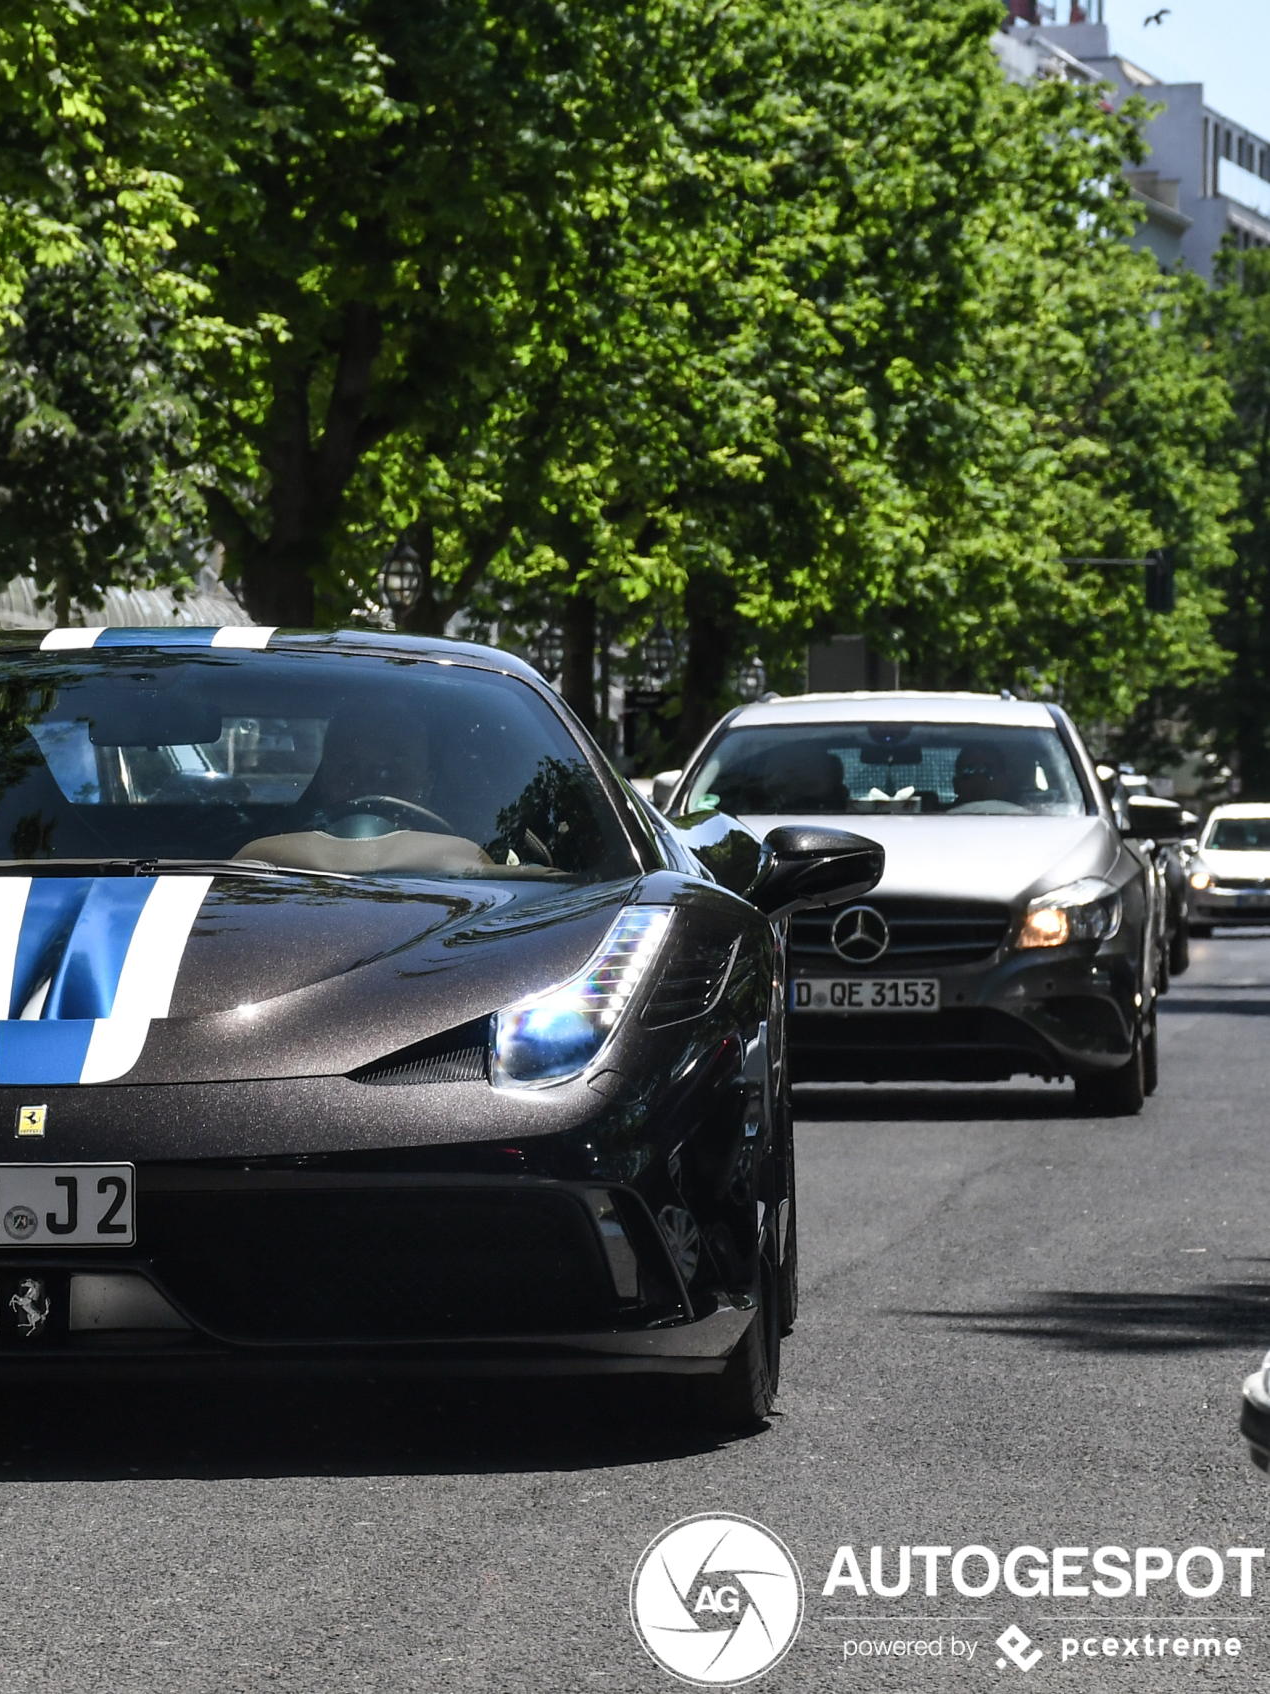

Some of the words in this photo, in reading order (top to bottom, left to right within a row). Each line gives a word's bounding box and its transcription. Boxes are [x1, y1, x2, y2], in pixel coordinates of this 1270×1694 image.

[795, 982, 812, 1007] D
[830, 982, 863, 1007] QE
[871, 982, 936, 1007] 3153
[46, 1177, 77, 1234] J
[96, 1177, 128, 1234] 2
